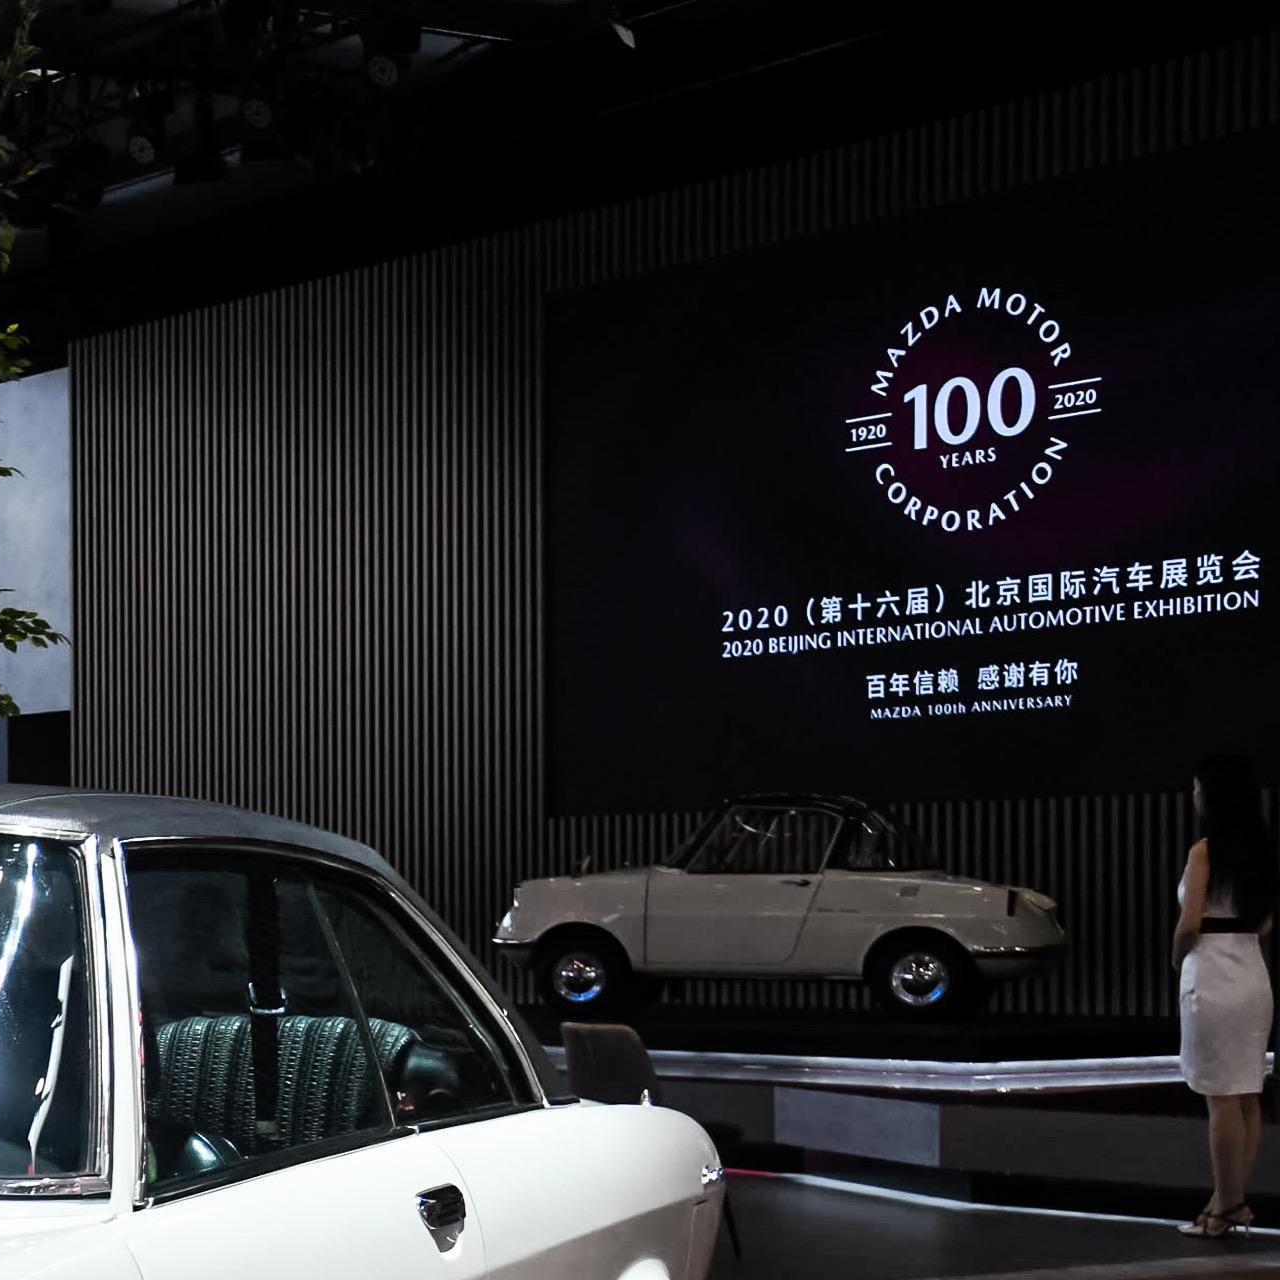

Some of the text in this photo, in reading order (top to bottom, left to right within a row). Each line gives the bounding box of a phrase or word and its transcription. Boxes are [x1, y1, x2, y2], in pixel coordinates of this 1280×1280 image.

[871, 288, 1072, 397] MAZDA MOTOR
[902, 366, 1036, 450] 100
[1054, 388, 1097, 409] 2020
[850, 422, 887, 442] 1920
[939, 446, 997, 469] YEARS
[874, 436, 1068, 532] CORPORATION
[722, 589, 1260, 658] 2020 BEIJING INTERNATIONAL AUTOMOTIVE EXHIBITION
[866, 660, 1079, 700] 百年信赖 感谢有你
[870, 694, 1072, 720] MAZDA 100th ANNIVERSARY
